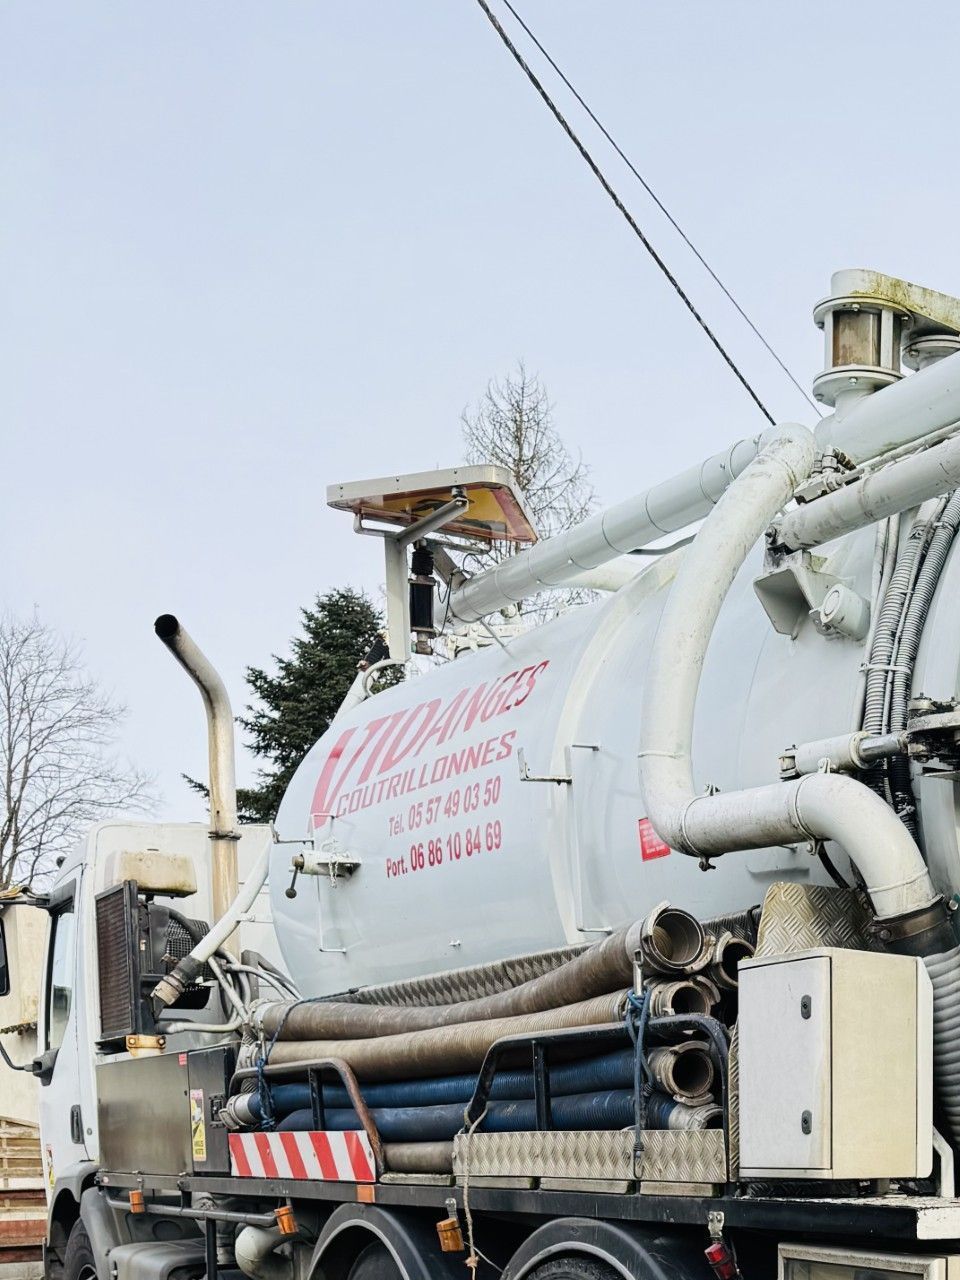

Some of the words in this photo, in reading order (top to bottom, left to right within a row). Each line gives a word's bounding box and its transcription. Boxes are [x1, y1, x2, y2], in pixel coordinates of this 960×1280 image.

[309, 659, 550, 829] VIDANGES
[336, 730, 516, 818] COUTRILLONNES
[389, 813, 404, 836] Tél.
[408, 801, 423, 831] 05
[426, 795, 442, 825] 57
[444, 789, 460, 818] 49
[463, 782, 480, 813] 03
[484, 775, 501, 807] 50
[386, 855, 408, 878] Port.
[410, 842, 424, 871] 06
[428, 837, 442, 867] 86
[446, 831, 461, 861] 10
[465, 825, 481, 857] 84
[485, 819, 501, 852] 69
